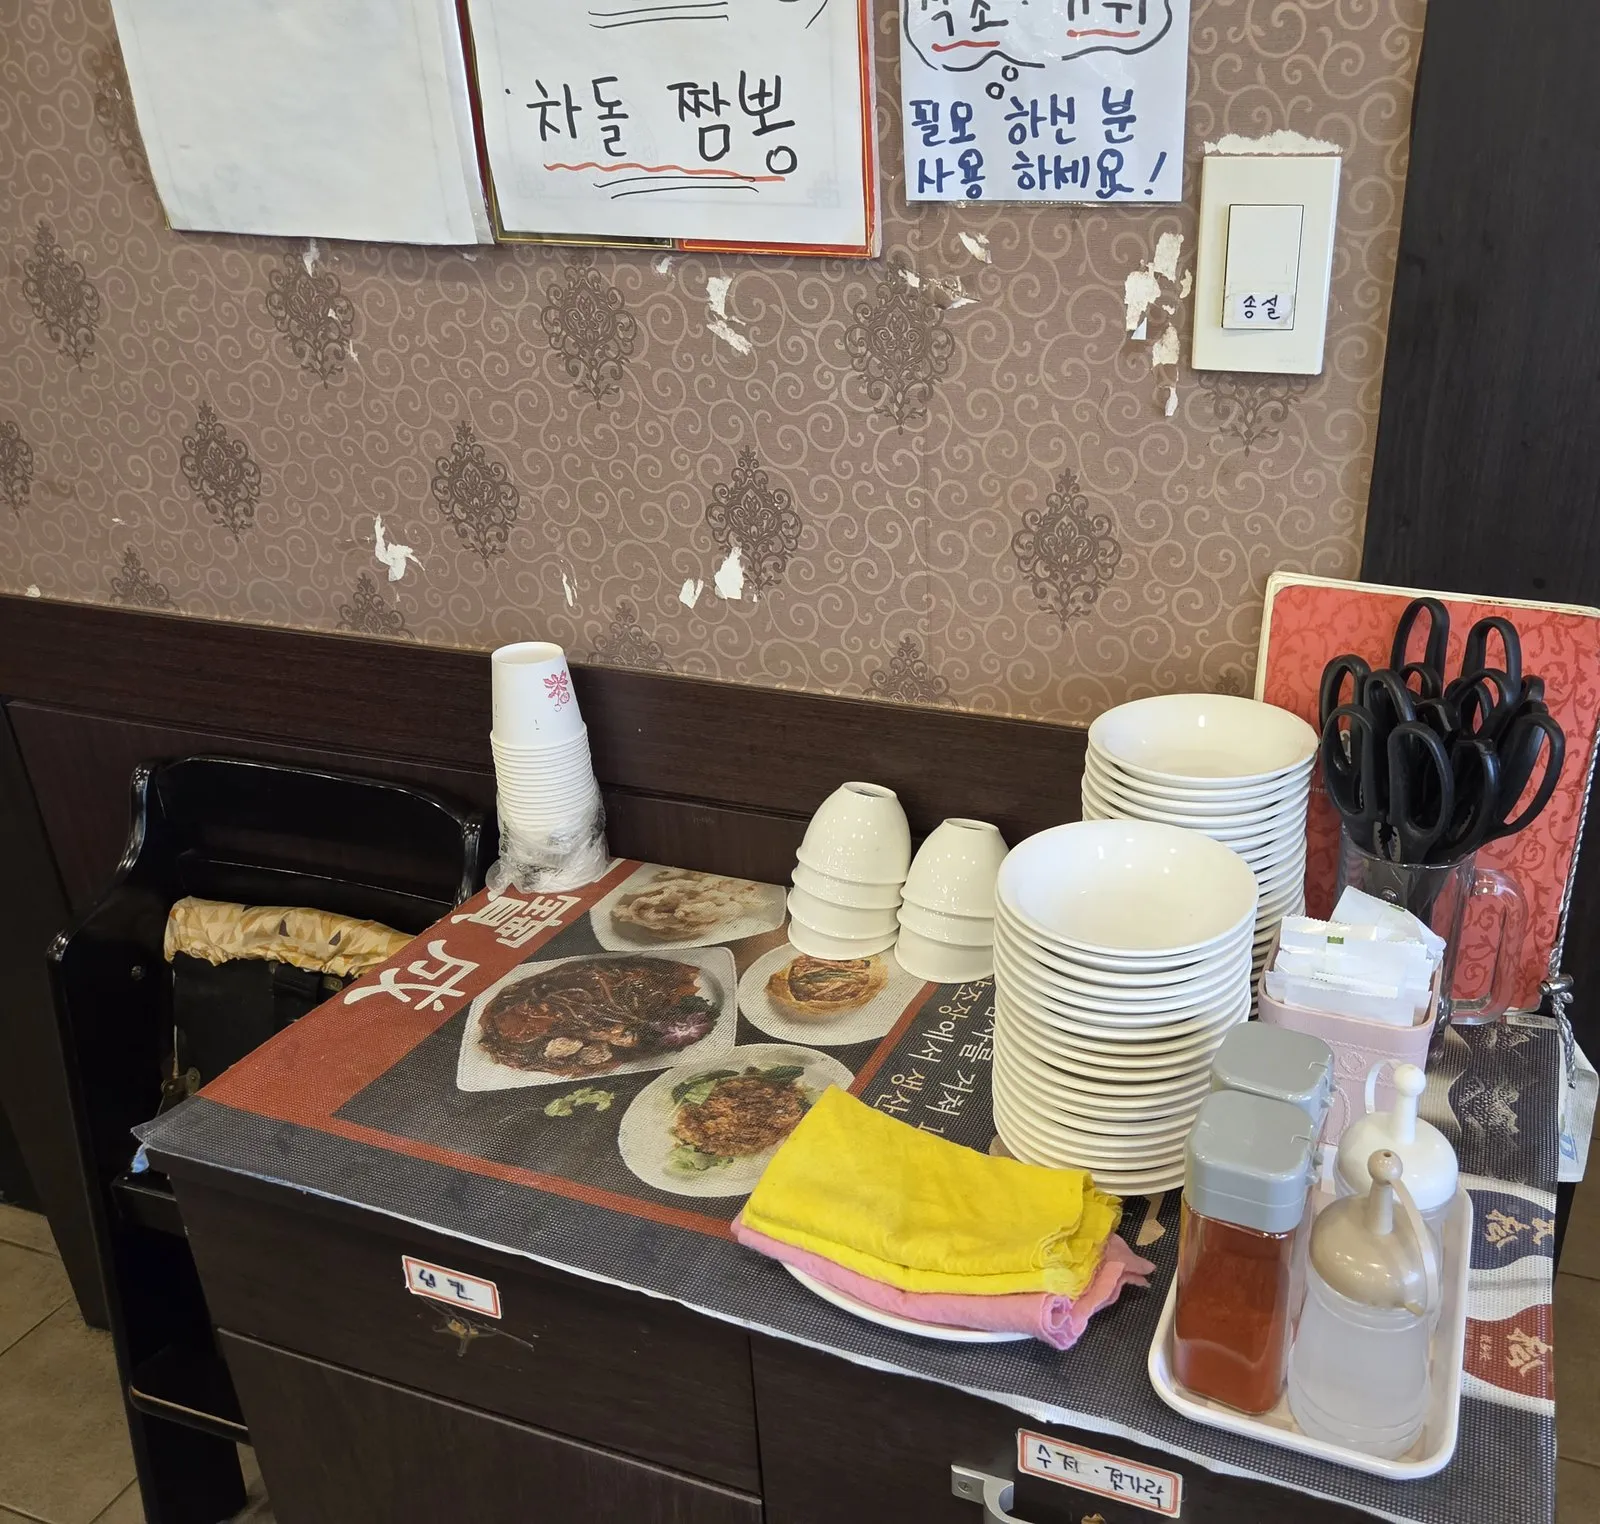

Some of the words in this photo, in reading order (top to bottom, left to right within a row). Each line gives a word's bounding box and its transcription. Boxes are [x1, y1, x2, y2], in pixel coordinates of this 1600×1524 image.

[526, 76, 629, 158] 차돌
[666, 70, 798, 175] 짬뽕
[909, 99, 976, 147] 필요
[1003, 93, 1077, 145] 하신
[1101, 86, 1137, 143] 분
[917, 148, 986, 199] 사용
[1011, 148, 1167, 199] 하세요!
[873, 1067, 926, 1113] 생산
[924, 1069, 976, 1116] 거쳐
